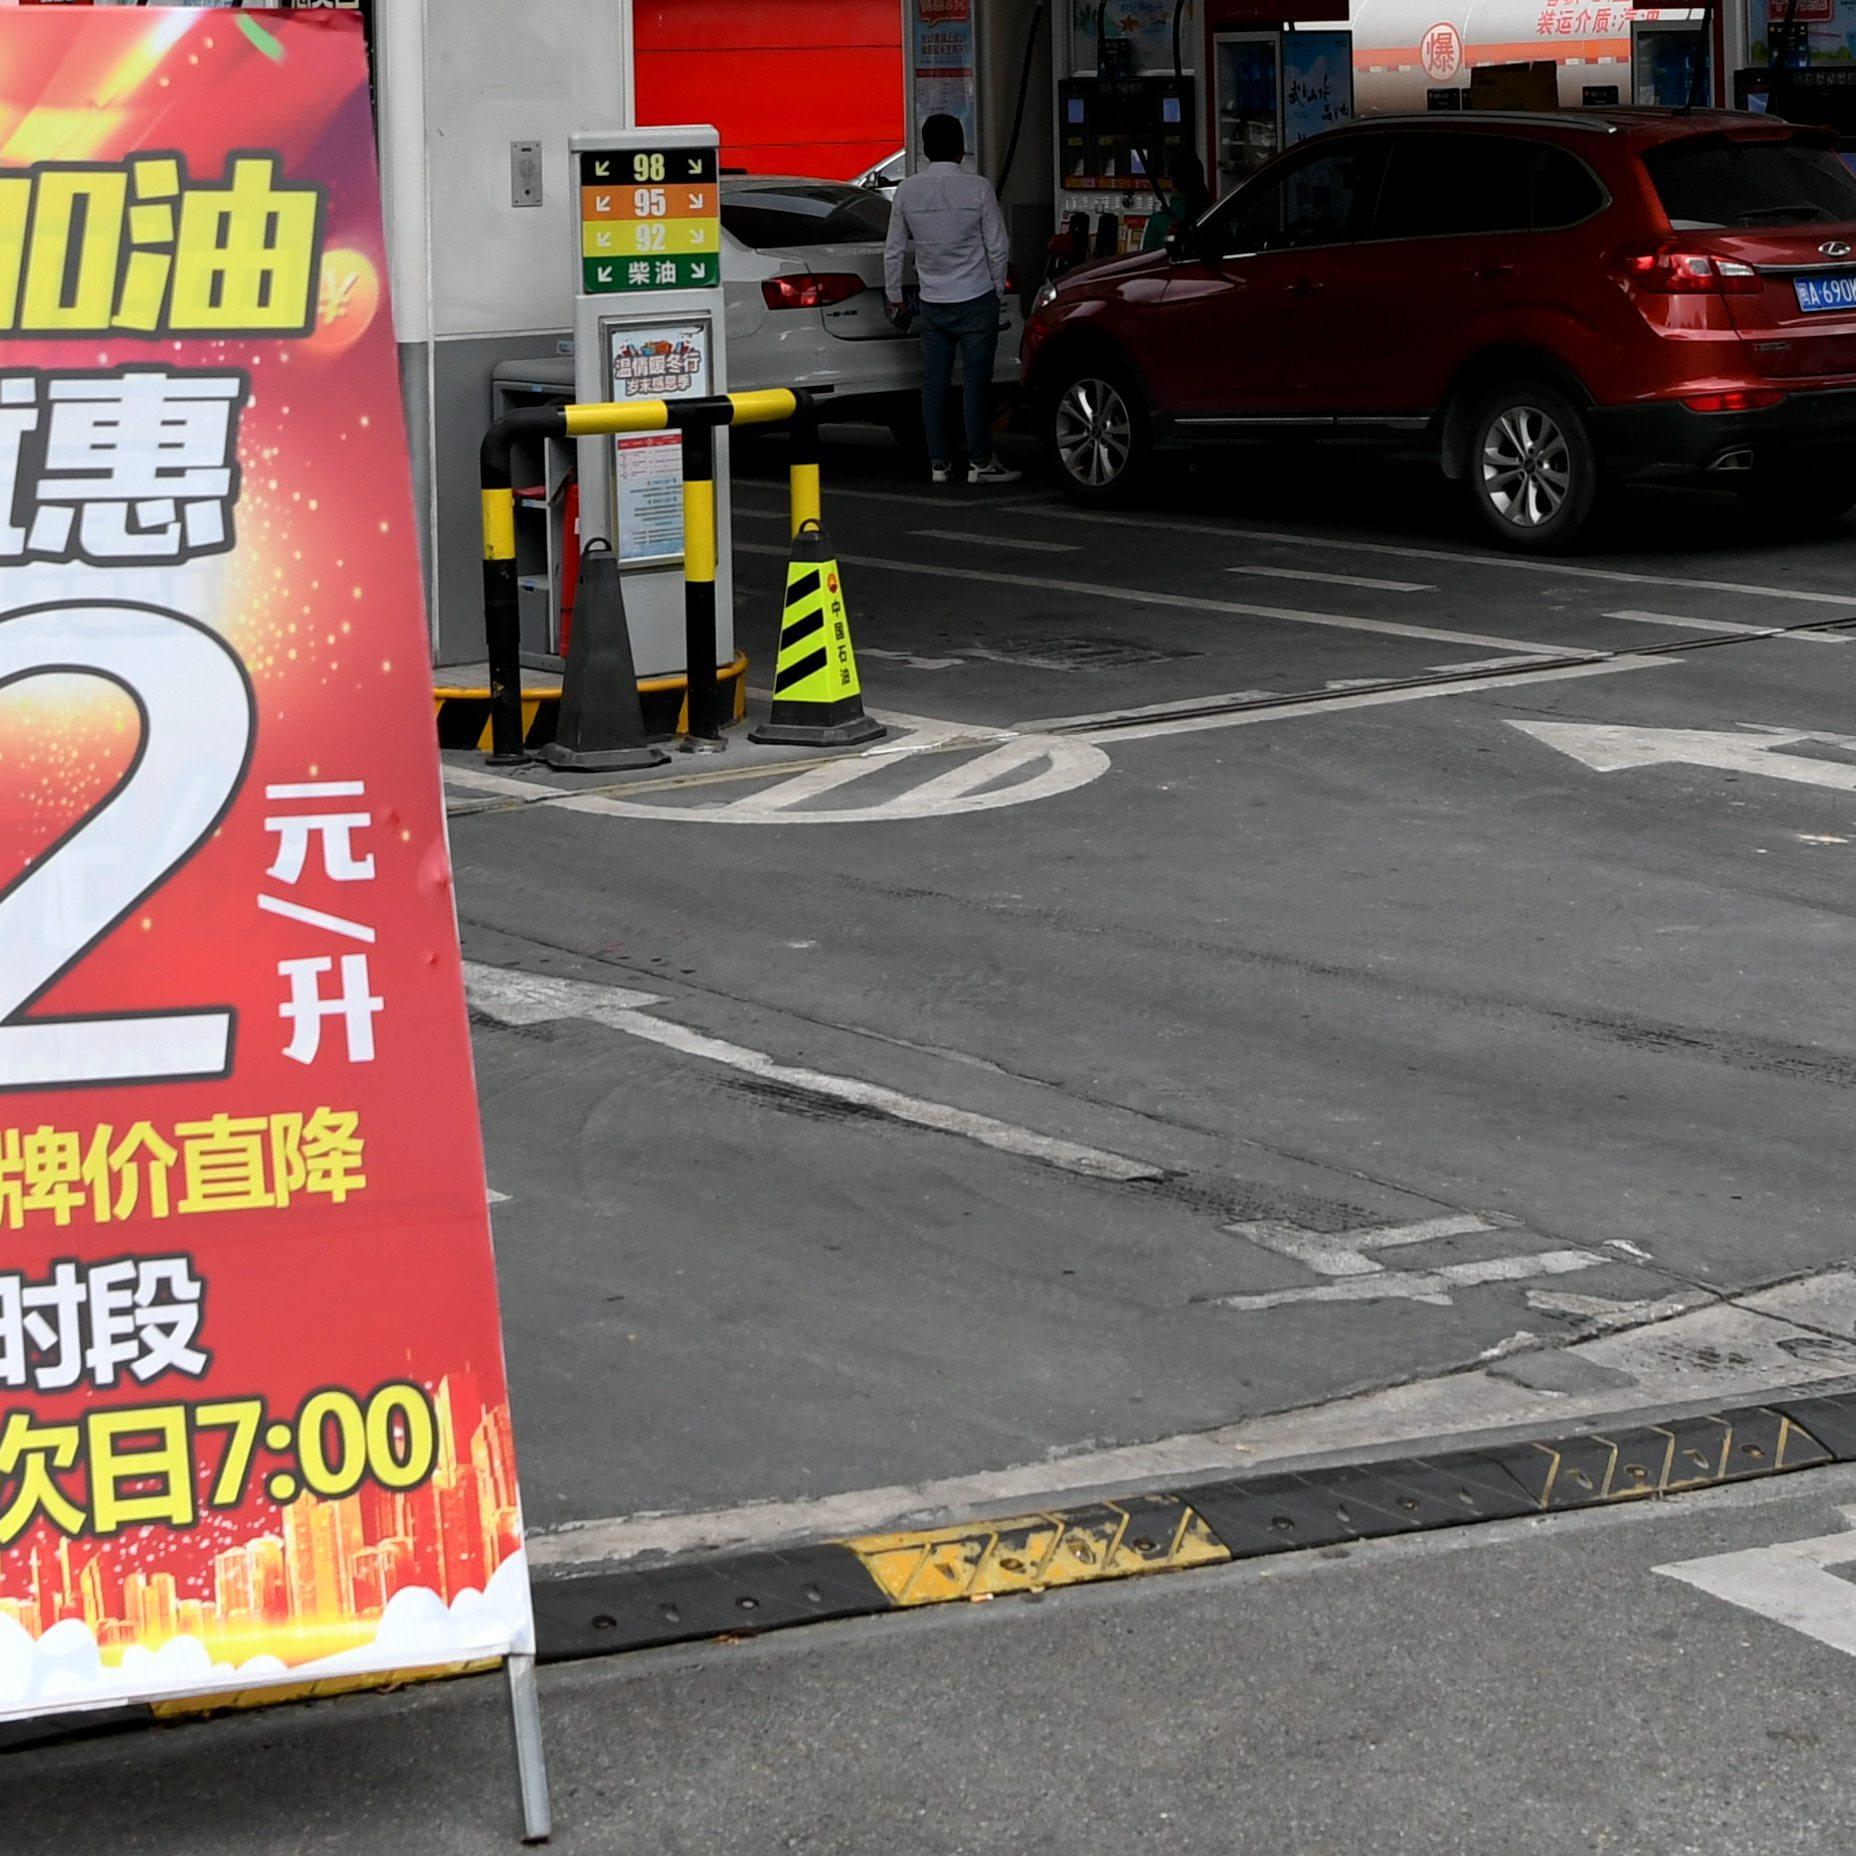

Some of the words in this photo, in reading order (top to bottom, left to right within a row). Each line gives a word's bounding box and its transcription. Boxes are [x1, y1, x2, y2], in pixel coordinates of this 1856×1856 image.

[1428, 32, 1455, 72] 爆
[633, 153, 665, 182] 98
[633, 189, 666, 217] 95
[635, 223, 667, 251] 92
[628, 260, 677, 286] 柴油
